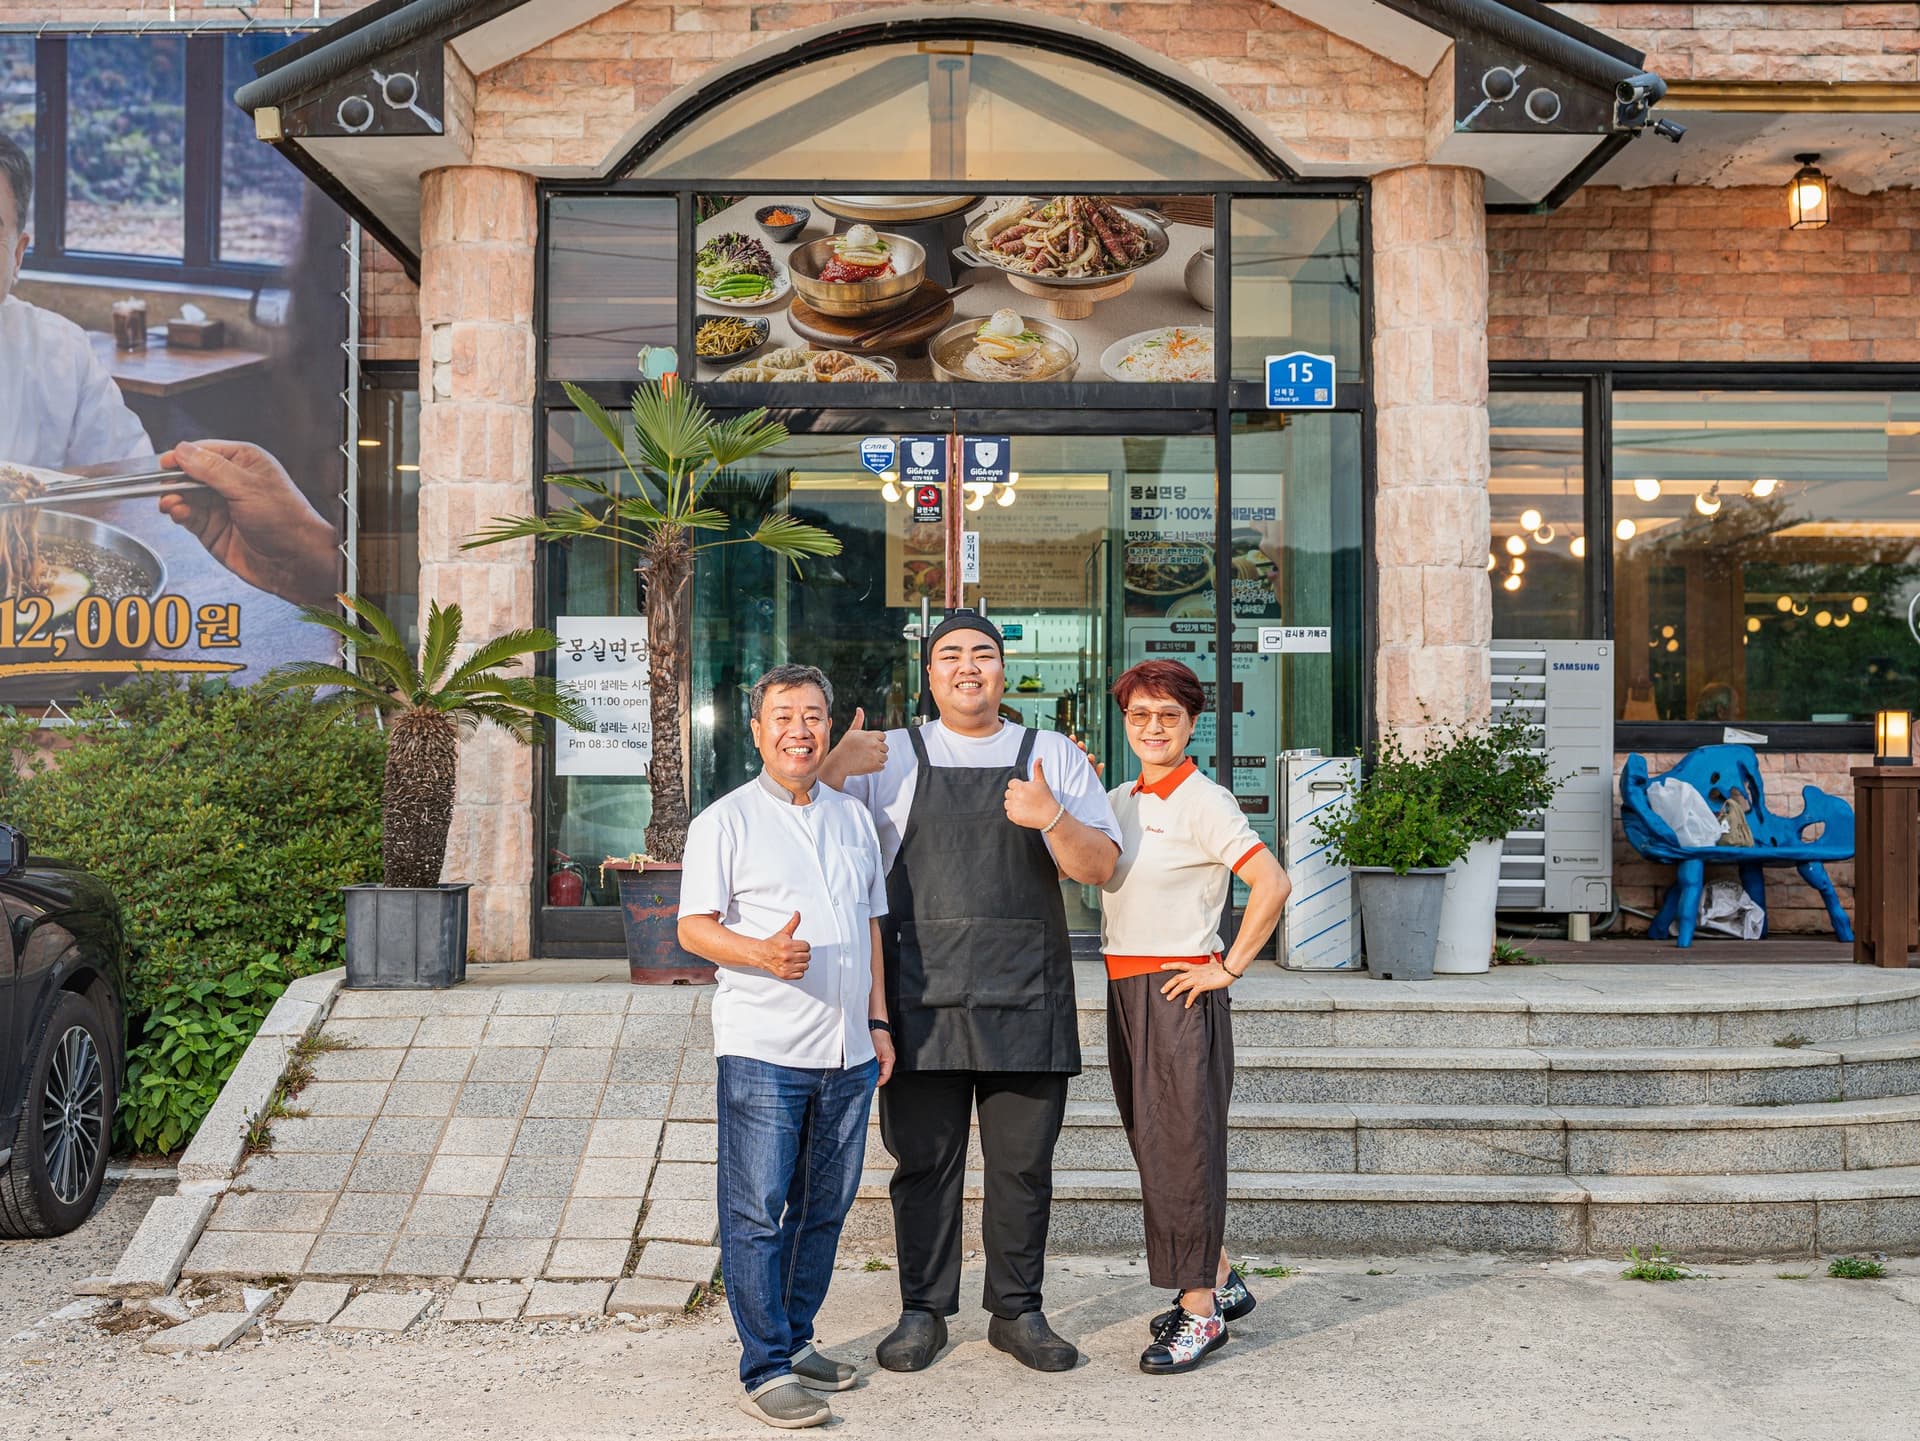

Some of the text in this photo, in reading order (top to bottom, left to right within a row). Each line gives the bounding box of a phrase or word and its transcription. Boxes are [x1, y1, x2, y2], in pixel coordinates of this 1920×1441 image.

[1288, 362, 1314, 383] 15
[1130, 485, 1187, 500] 몽실면당
[1130, 507, 1168, 521] 불고기
[1175, 507, 1213, 520] 100%
[1128, 530, 1161, 542] 맛있게
[966, 534, 975, 571] 당기시오
[0, 594, 242, 658] 12,000원
[1175, 623, 1198, 633] 맛있게
[1284, 630, 1327, 638] 감시용 카메라
[565, 637, 650, 663] 몽실면당
[1552, 662, 1600, 672] SAMSUNG
[599, 679, 629, 692] 설레는
[591, 696, 620, 706] 11:00
[622, 697, 649, 709] open
[599, 721, 629, 734] 설레는
[631, 721, 650, 734] 시간
[569, 738, 648, 749] Pm 08:30 close
